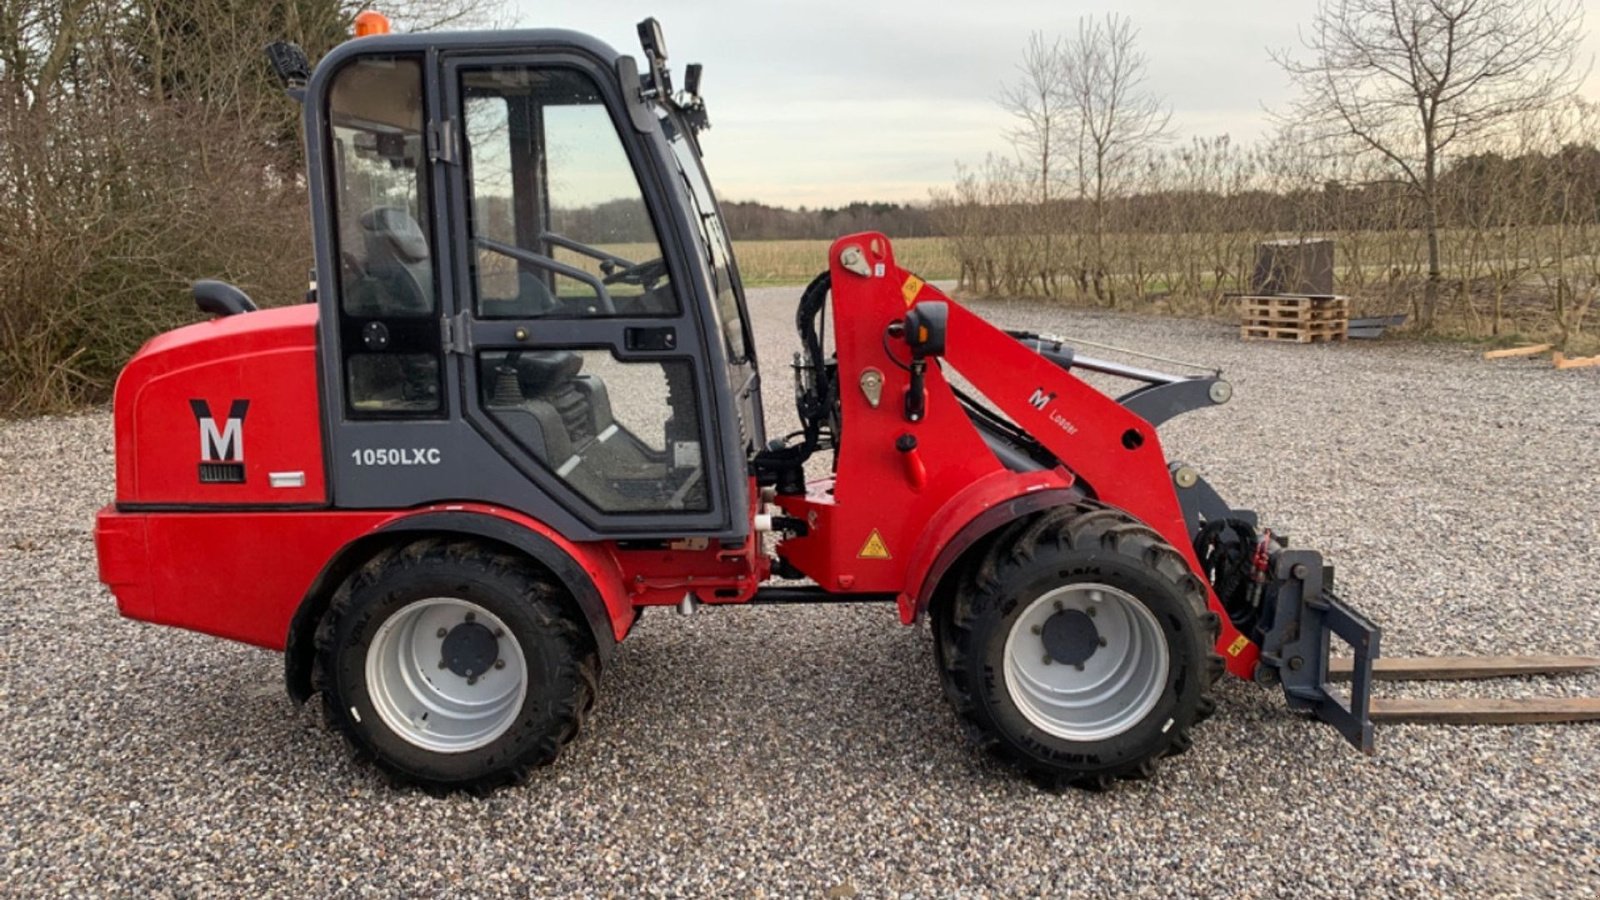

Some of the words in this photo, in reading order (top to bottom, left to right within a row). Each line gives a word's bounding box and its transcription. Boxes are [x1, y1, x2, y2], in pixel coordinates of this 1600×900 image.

[1028, 388, 1051, 411] M
[199, 416, 244, 462] M
[351, 447, 441, 466] 1050LXC
